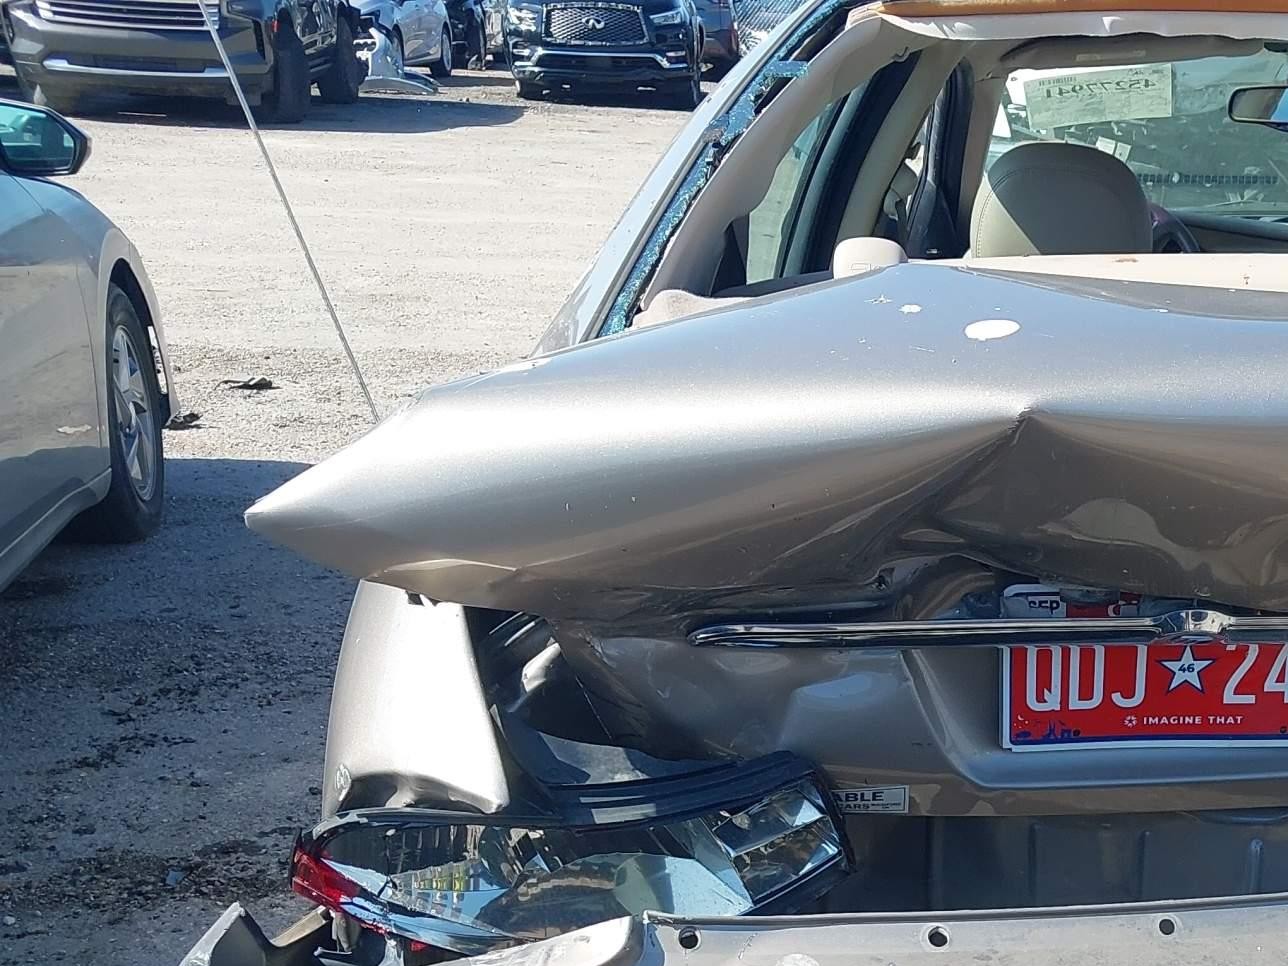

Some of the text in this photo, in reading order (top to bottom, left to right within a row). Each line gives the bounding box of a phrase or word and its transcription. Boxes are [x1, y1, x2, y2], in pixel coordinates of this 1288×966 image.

[1026, 644, 1148, 712] QDJ
[1178, 663, 1195, 674] 46
[1143, 715, 1243, 725] IMAGINE THAT
